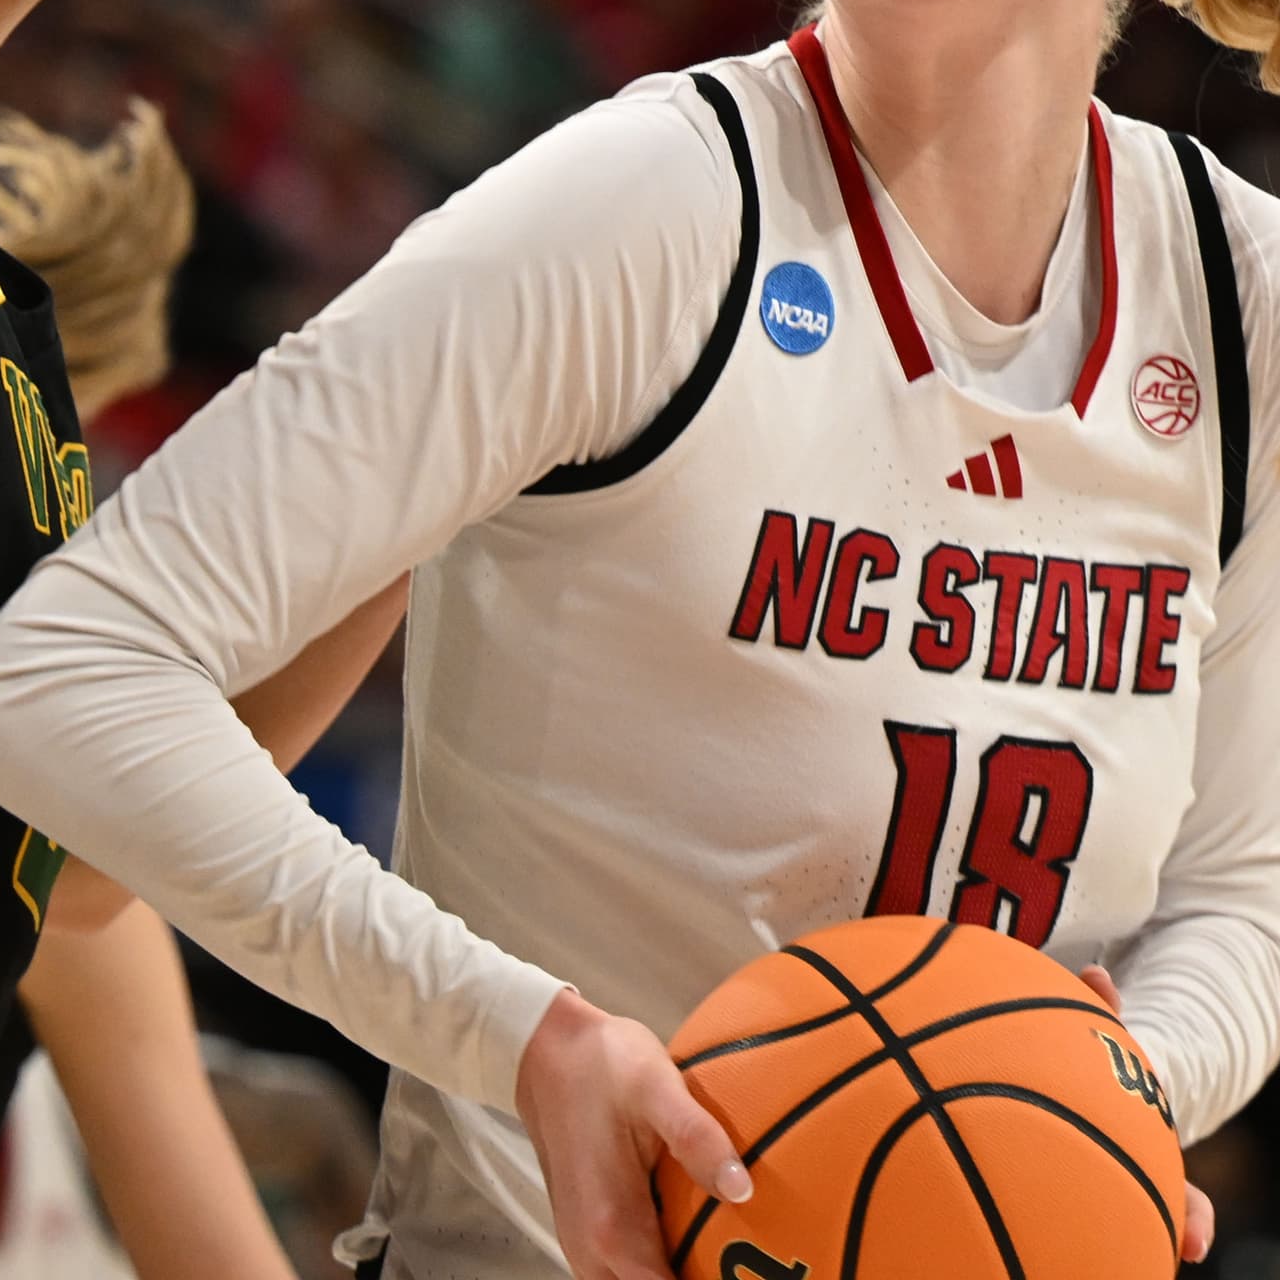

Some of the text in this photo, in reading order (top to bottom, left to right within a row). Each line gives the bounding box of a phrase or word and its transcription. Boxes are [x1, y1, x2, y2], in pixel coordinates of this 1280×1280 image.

[767, 297, 829, 337] NCAA
[1140, 381, 1195, 403] ACC
[728, 509, 1190, 695] NC STATE
[862, 719, 1094, 951] 18
